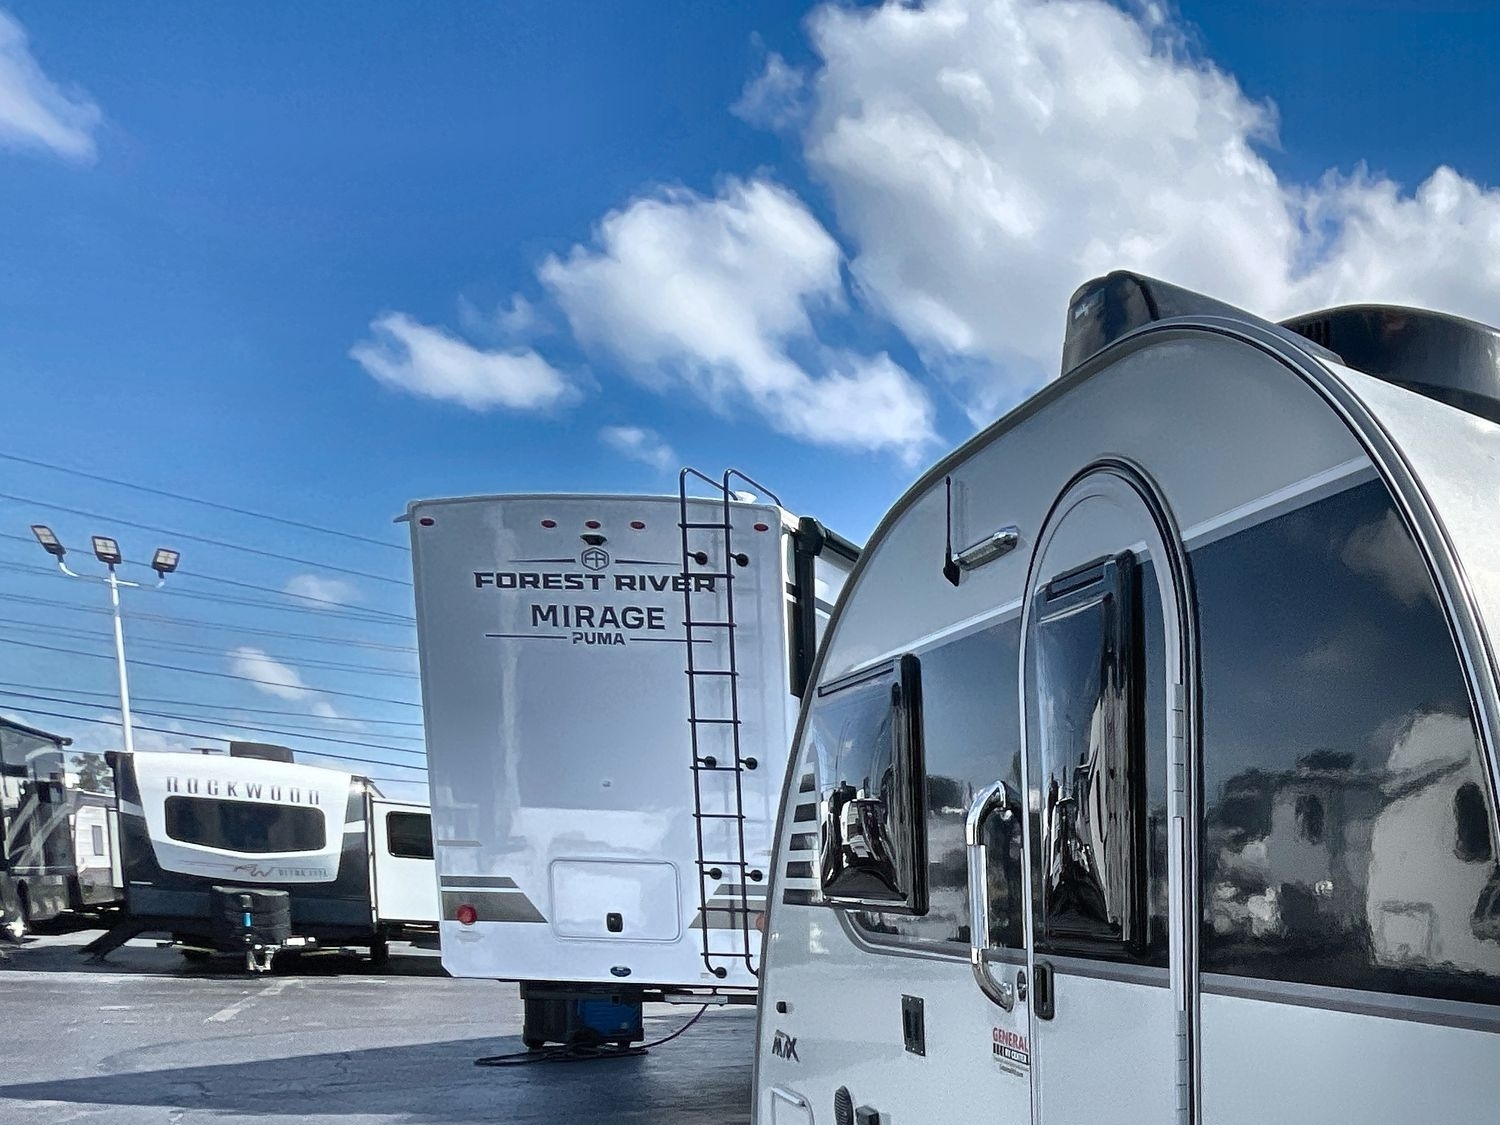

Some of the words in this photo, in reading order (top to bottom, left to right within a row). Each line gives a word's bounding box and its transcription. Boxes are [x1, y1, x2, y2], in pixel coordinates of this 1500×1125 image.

[474, 572, 606, 591] FOREST
[614, 574, 717, 592] RIVER
[531, 604, 666, 630] MIRAGE
[572, 632, 626, 646] PUMA
[992, 1027, 1029, 1053] GENERAL
